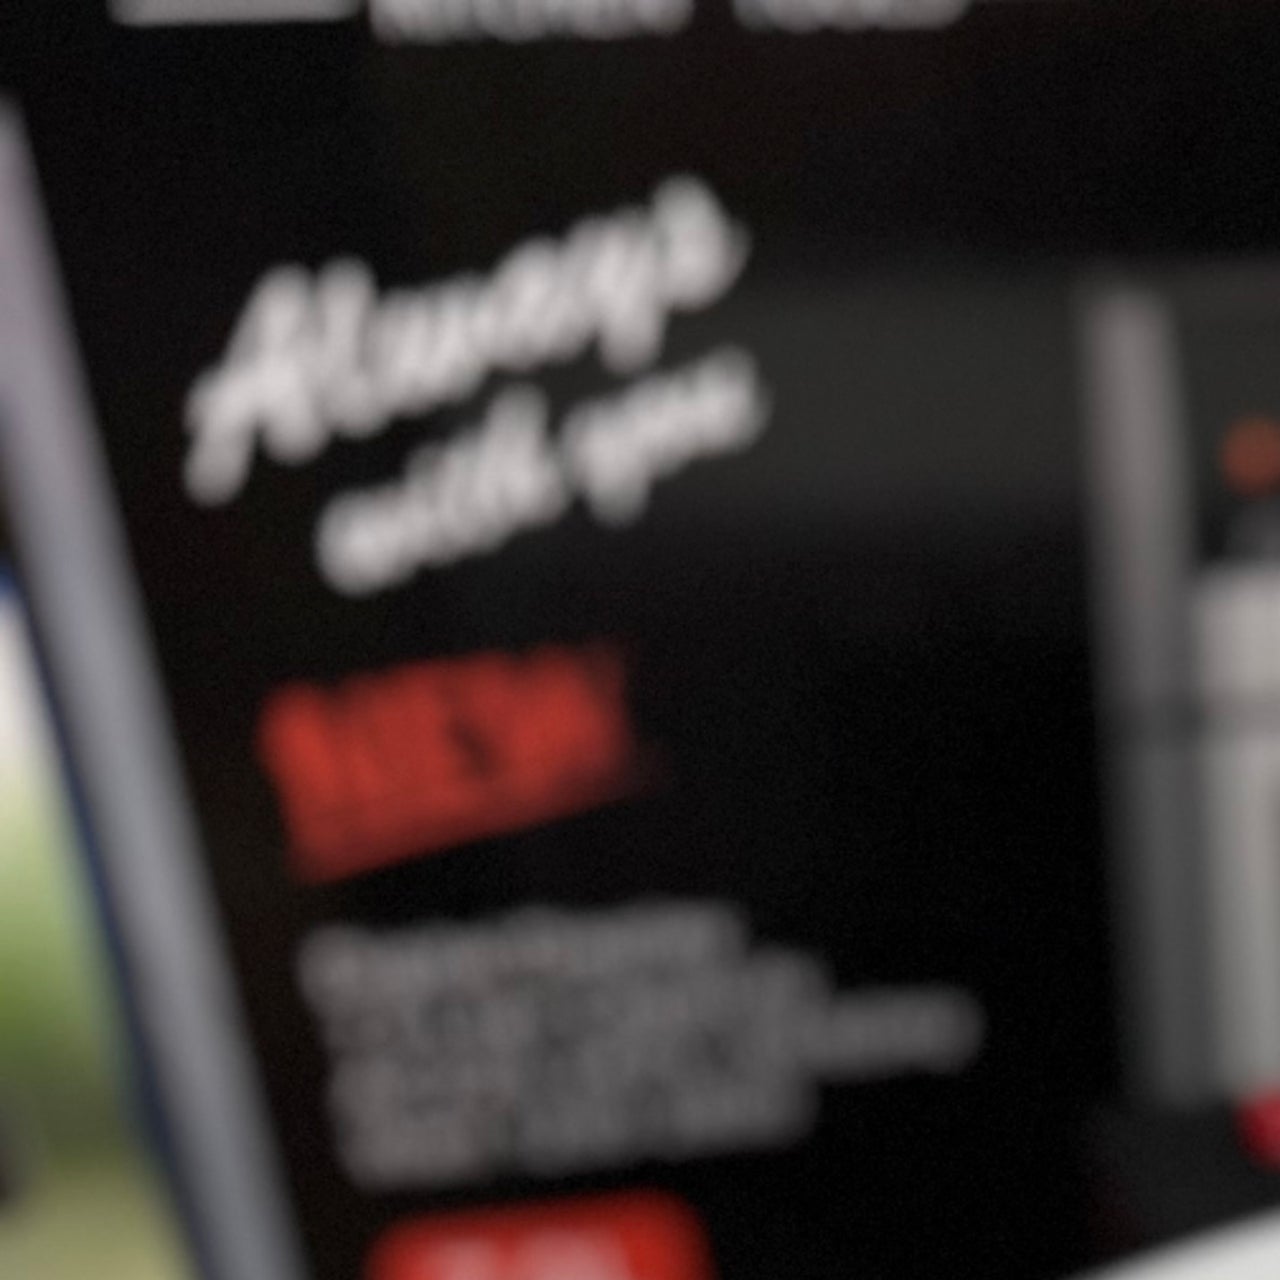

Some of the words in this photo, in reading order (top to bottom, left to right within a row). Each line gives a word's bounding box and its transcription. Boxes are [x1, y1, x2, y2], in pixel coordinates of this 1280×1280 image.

[190, 180, 745, 500] Always
[320, 392, 565, 590] with
[565, 352, 762, 520] you
